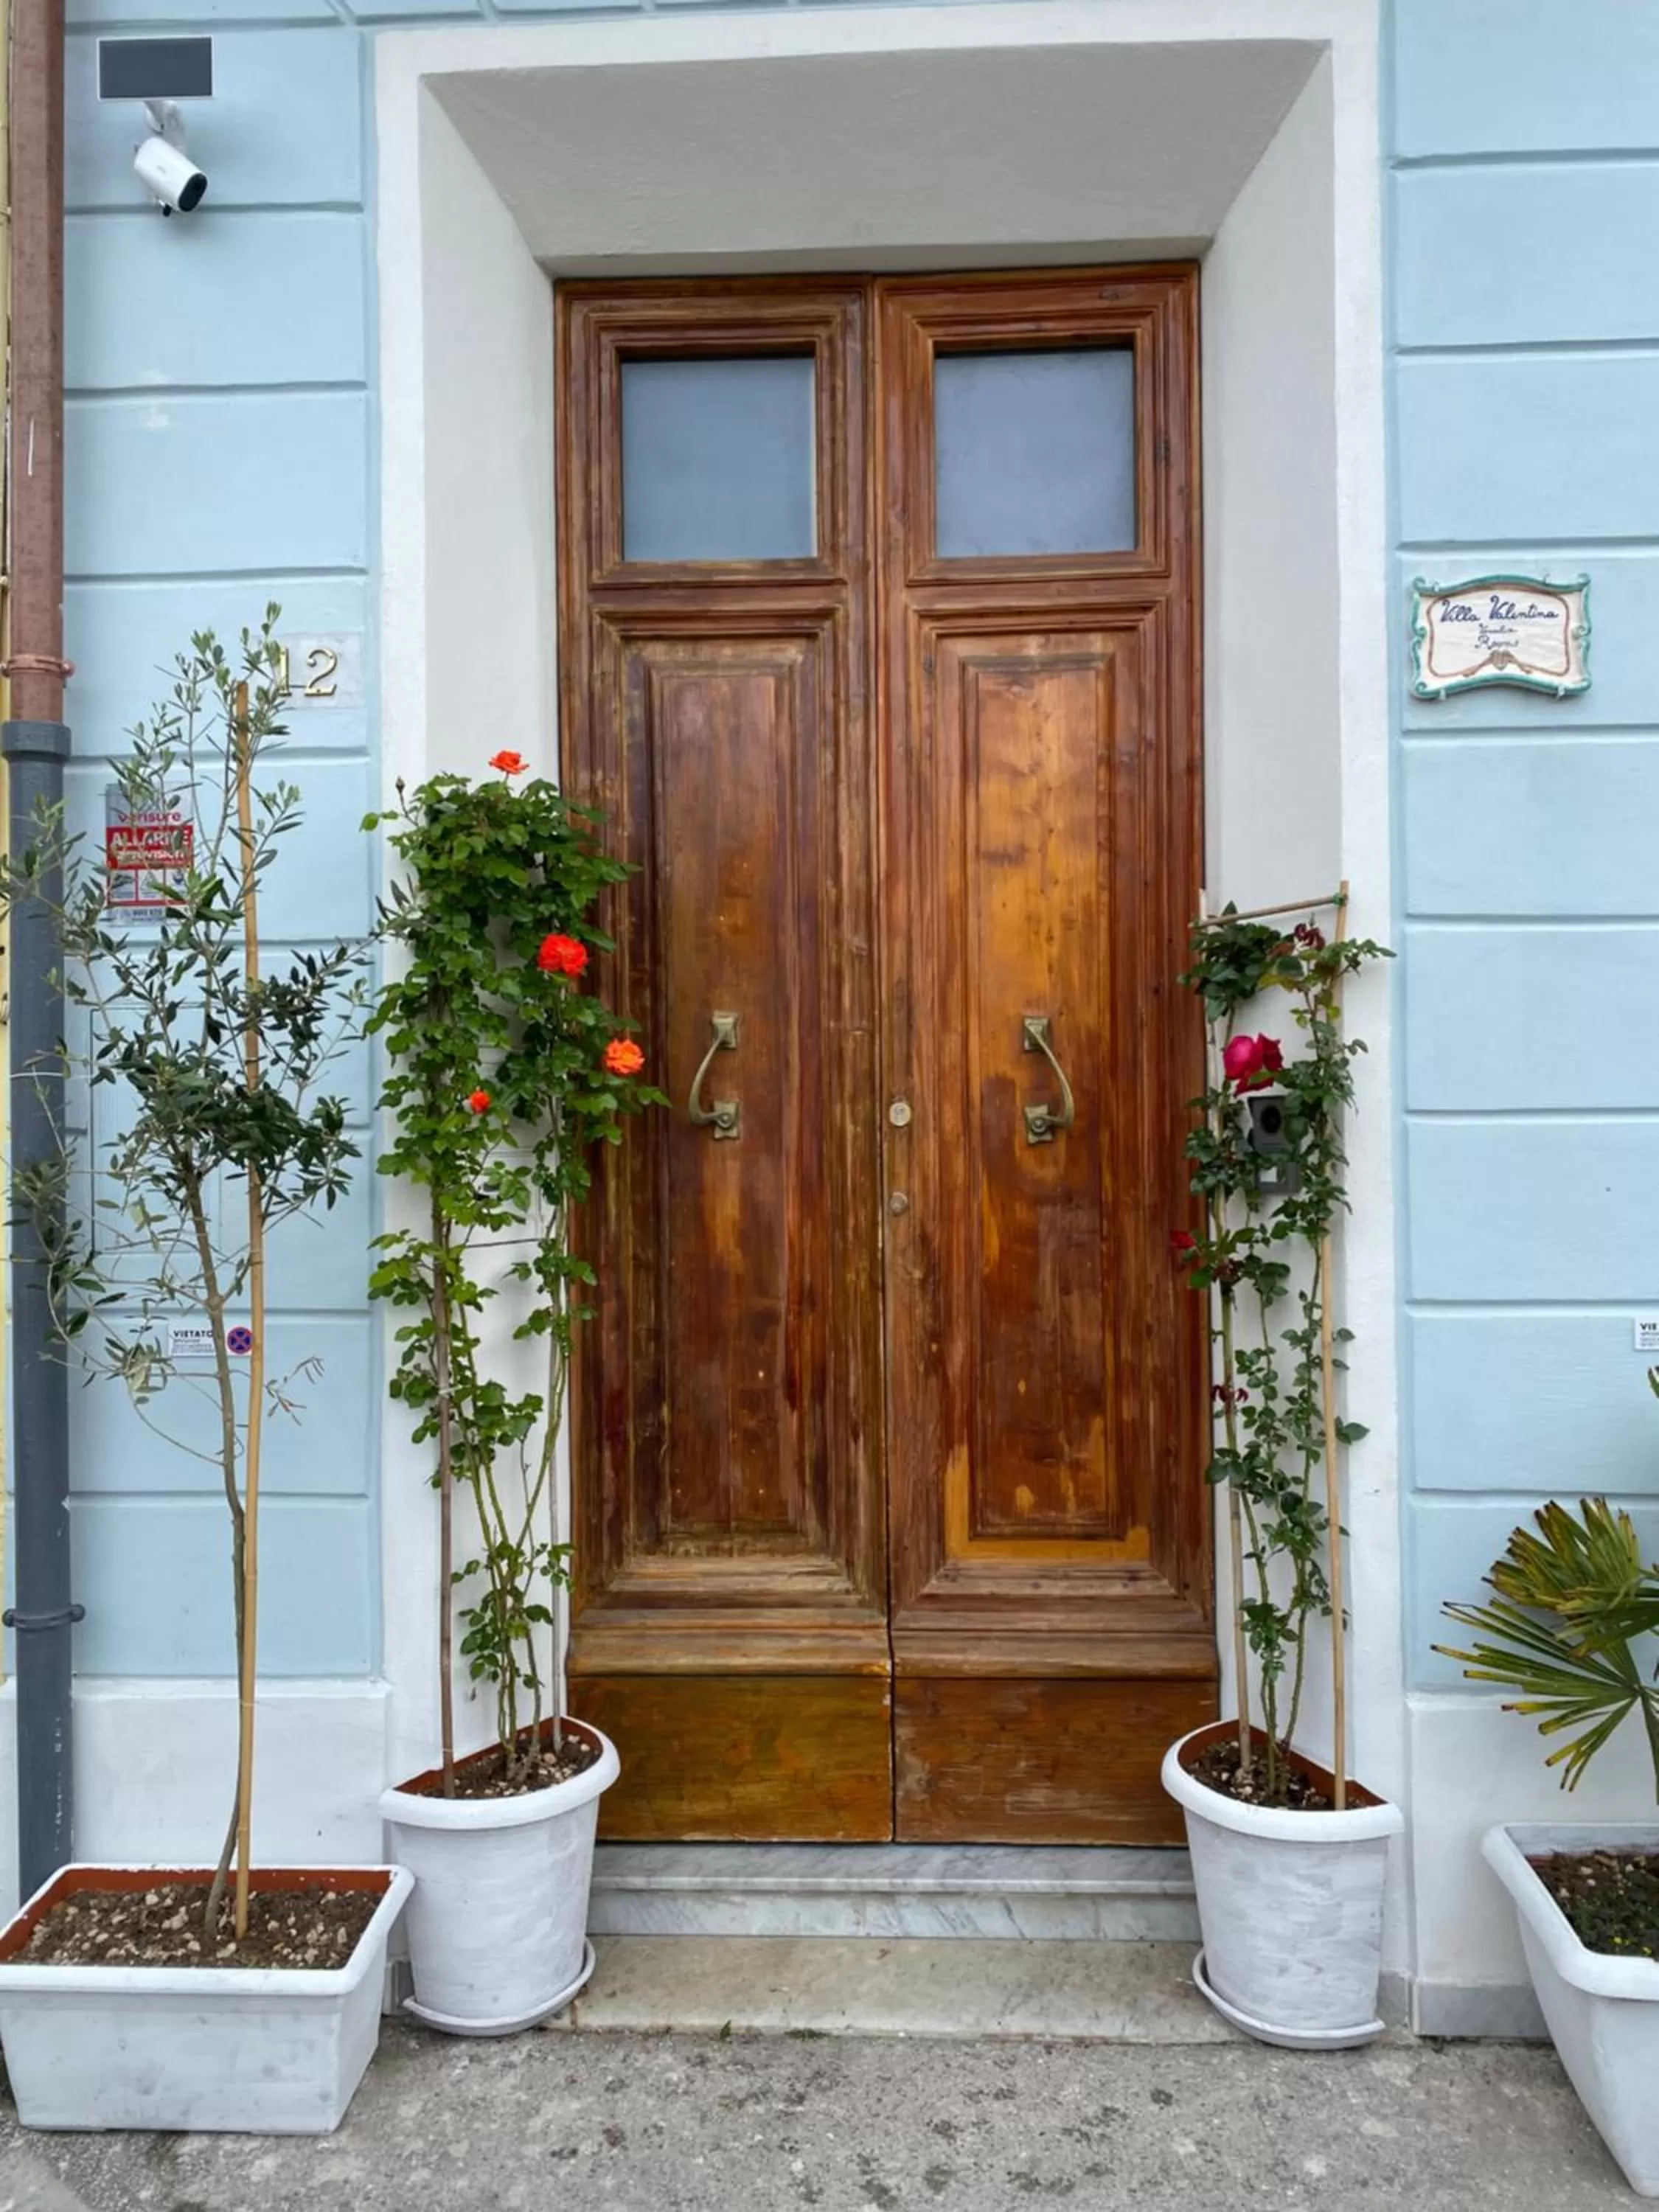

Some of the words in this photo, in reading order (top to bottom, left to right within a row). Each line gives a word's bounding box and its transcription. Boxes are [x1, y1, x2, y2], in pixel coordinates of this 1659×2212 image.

[1440, 599, 1481, 622] Villa
[1489, 595, 1559, 620] Valentina
[277, 647, 338, 697] 12
[173, 1329, 213, 1338] VIETATO
